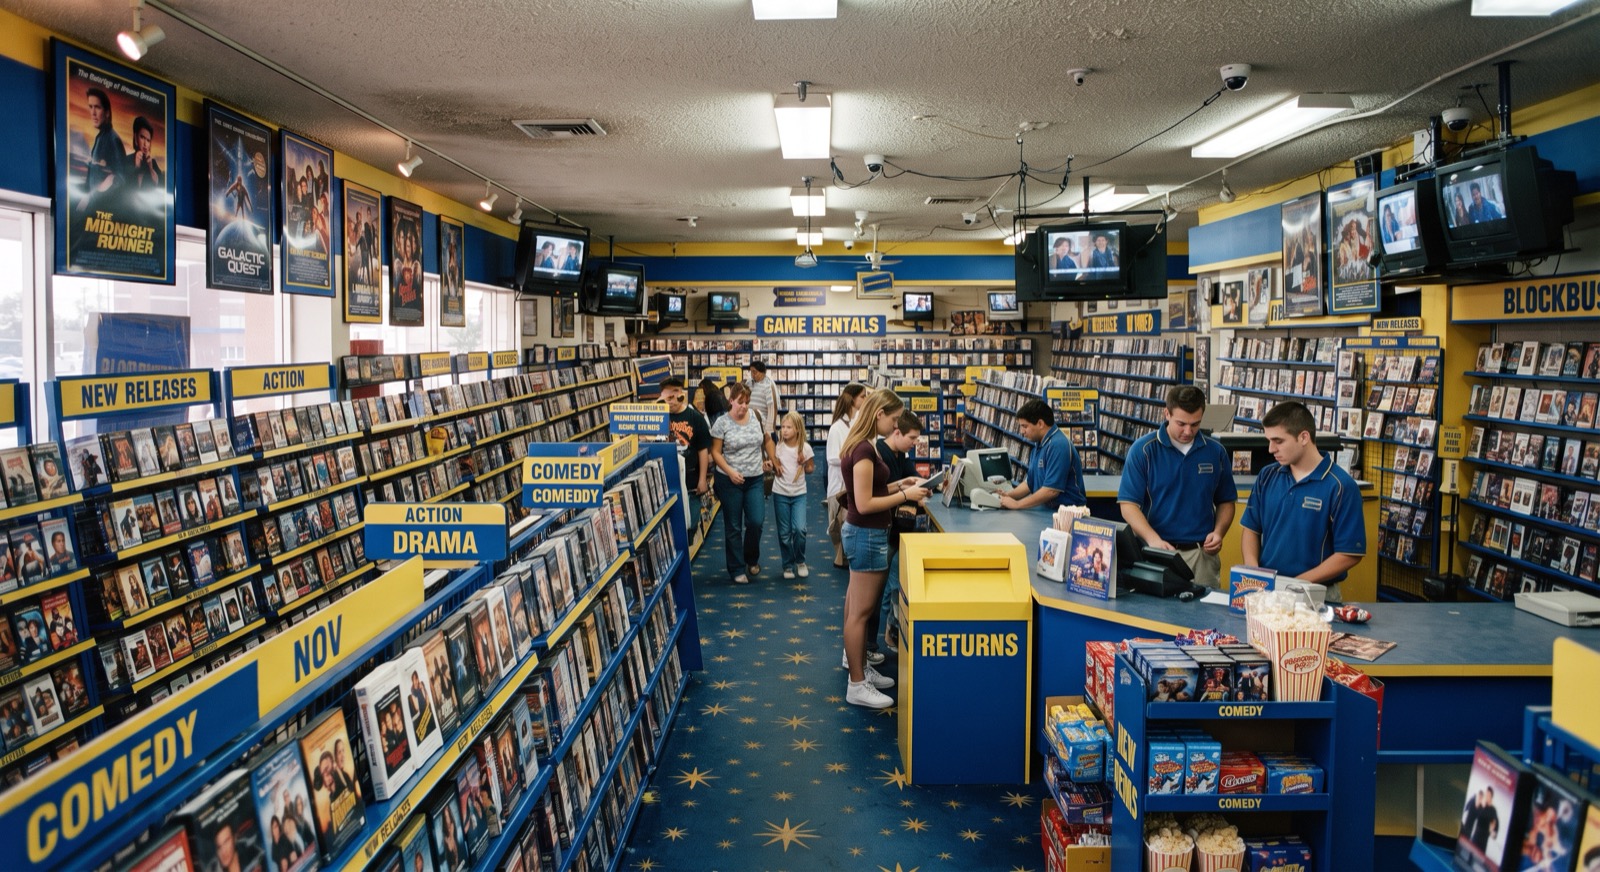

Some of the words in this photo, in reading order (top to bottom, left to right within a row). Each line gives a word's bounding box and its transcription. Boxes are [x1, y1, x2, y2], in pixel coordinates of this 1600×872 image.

[96, 210, 113, 220] THE
[84, 217, 155, 241] MIDNIGHT
[96, 234, 154, 255] RUNNER
[218, 247, 265, 266] GALACTIC
[227, 261, 261, 277] QUEST
[1504, 281, 1600, 314] BLOCKBU
[763, 317, 806, 334] GAME
[812, 317, 879, 334] RENTALS
[1376, 320, 1389, 329] NEW
[1390, 319, 1419, 329] RELEASES
[263, 369, 305, 391] ACTION
[81, 383, 118, 409] NEW
[125, 377, 197, 404] RELEASES
[531, 463, 602, 480] COMEDY
[532, 488, 600, 504] COMEDDY
[405, 507, 462, 522] ACTION
[393, 531, 478, 554] DRAMA
[294, 614, 343, 683] NOV
[922, 633, 1018, 657] RETURNS
[1218, 705, 1263, 717] COMEDY
[1117, 721, 1137, 773] NEW
[27, 708, 198, 863] COMEDY
[1218, 798, 1262, 809] COMEDY
